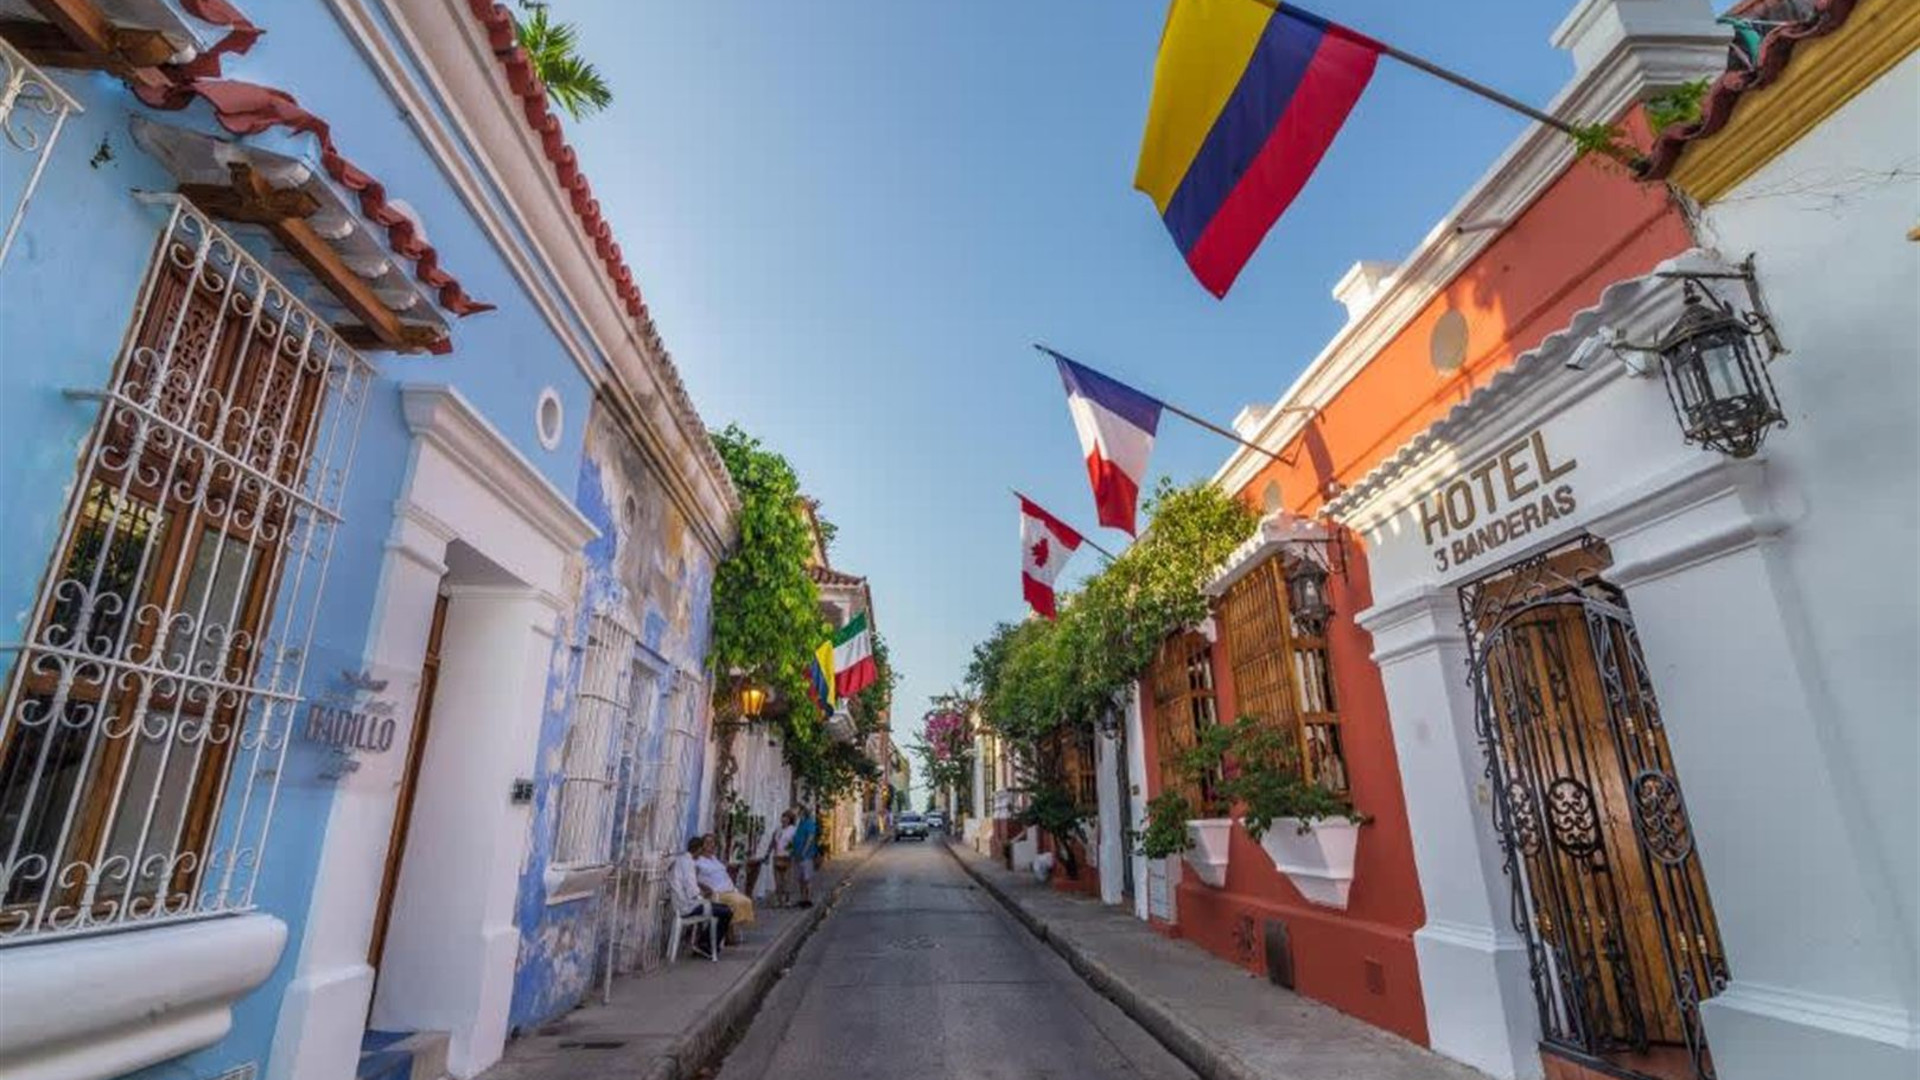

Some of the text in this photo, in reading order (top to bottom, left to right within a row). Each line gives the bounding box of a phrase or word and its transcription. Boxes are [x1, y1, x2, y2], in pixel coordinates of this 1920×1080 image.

[1419, 430, 1577, 545] HOTEL
[1434, 485, 1577, 572] 3 BANDERAS
